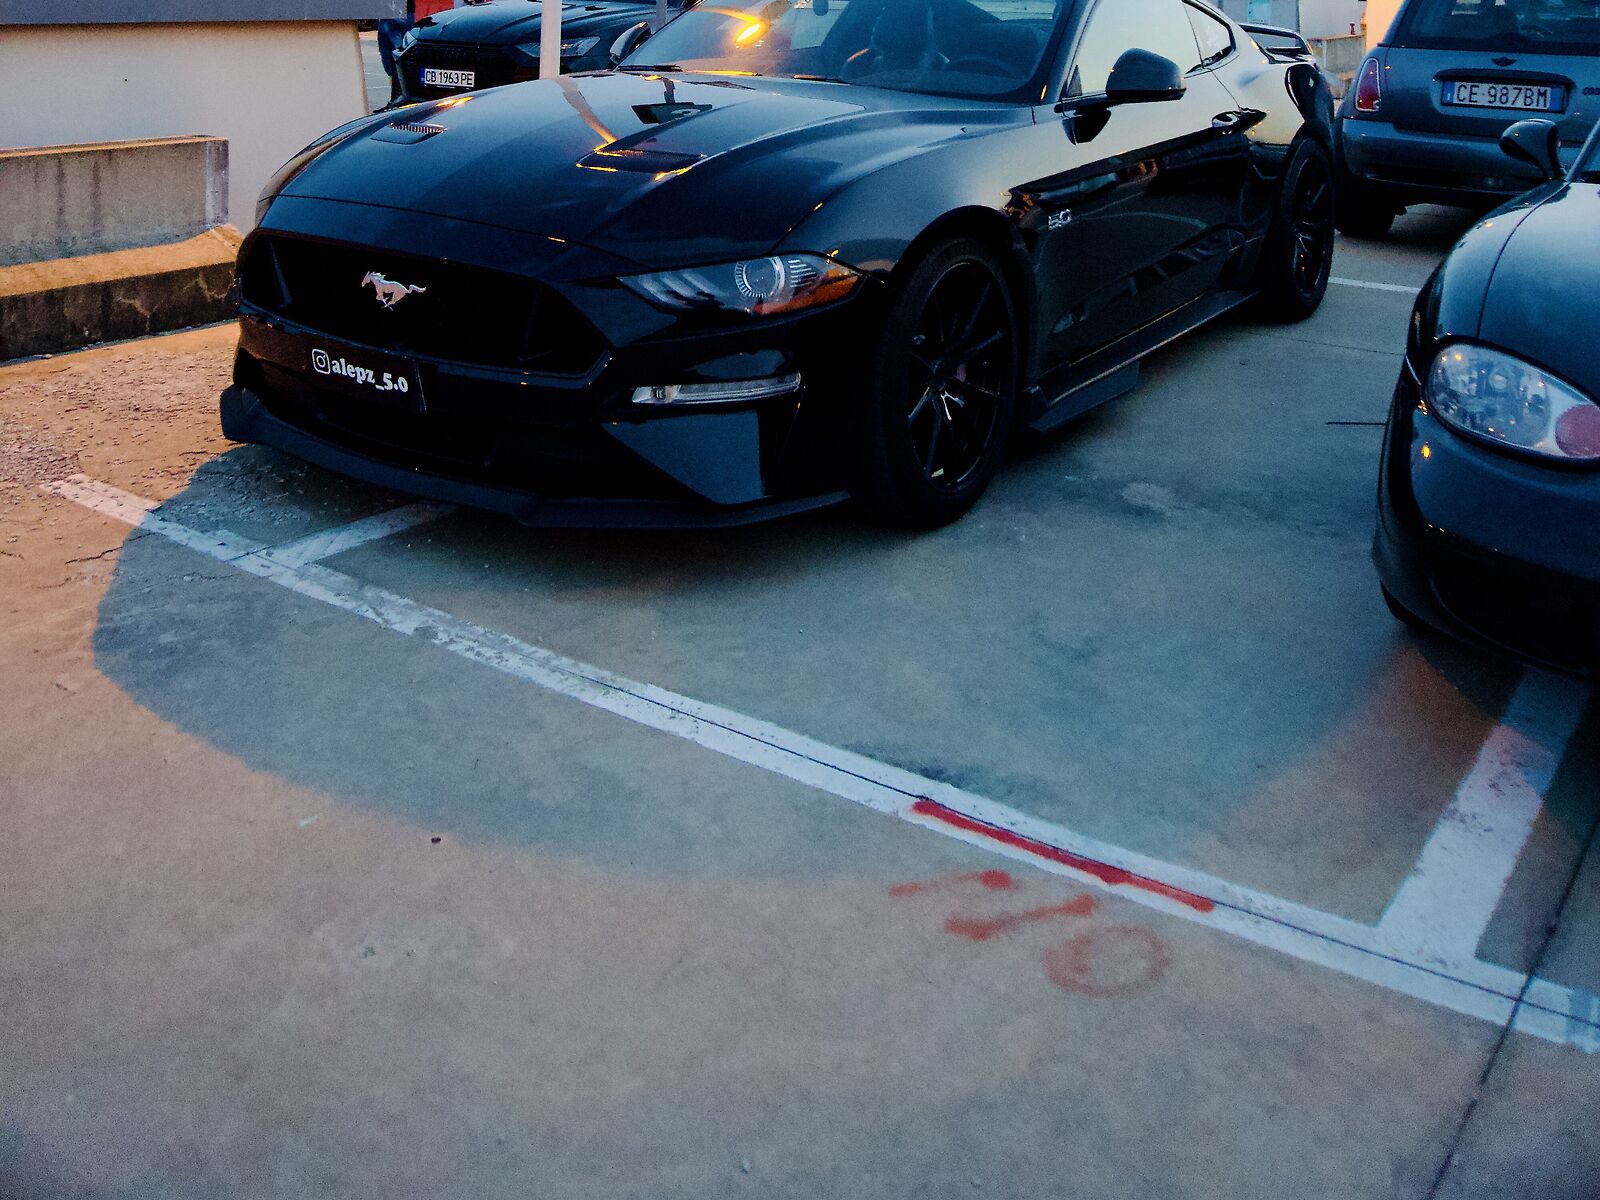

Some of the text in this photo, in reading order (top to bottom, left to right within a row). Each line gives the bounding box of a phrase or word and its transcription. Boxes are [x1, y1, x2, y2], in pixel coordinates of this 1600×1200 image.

[425, 70, 473, 86] CB 1963 PE
[1456, 83, 1480, 103] CE
[1487, 85, 1549, 108] 987BM
